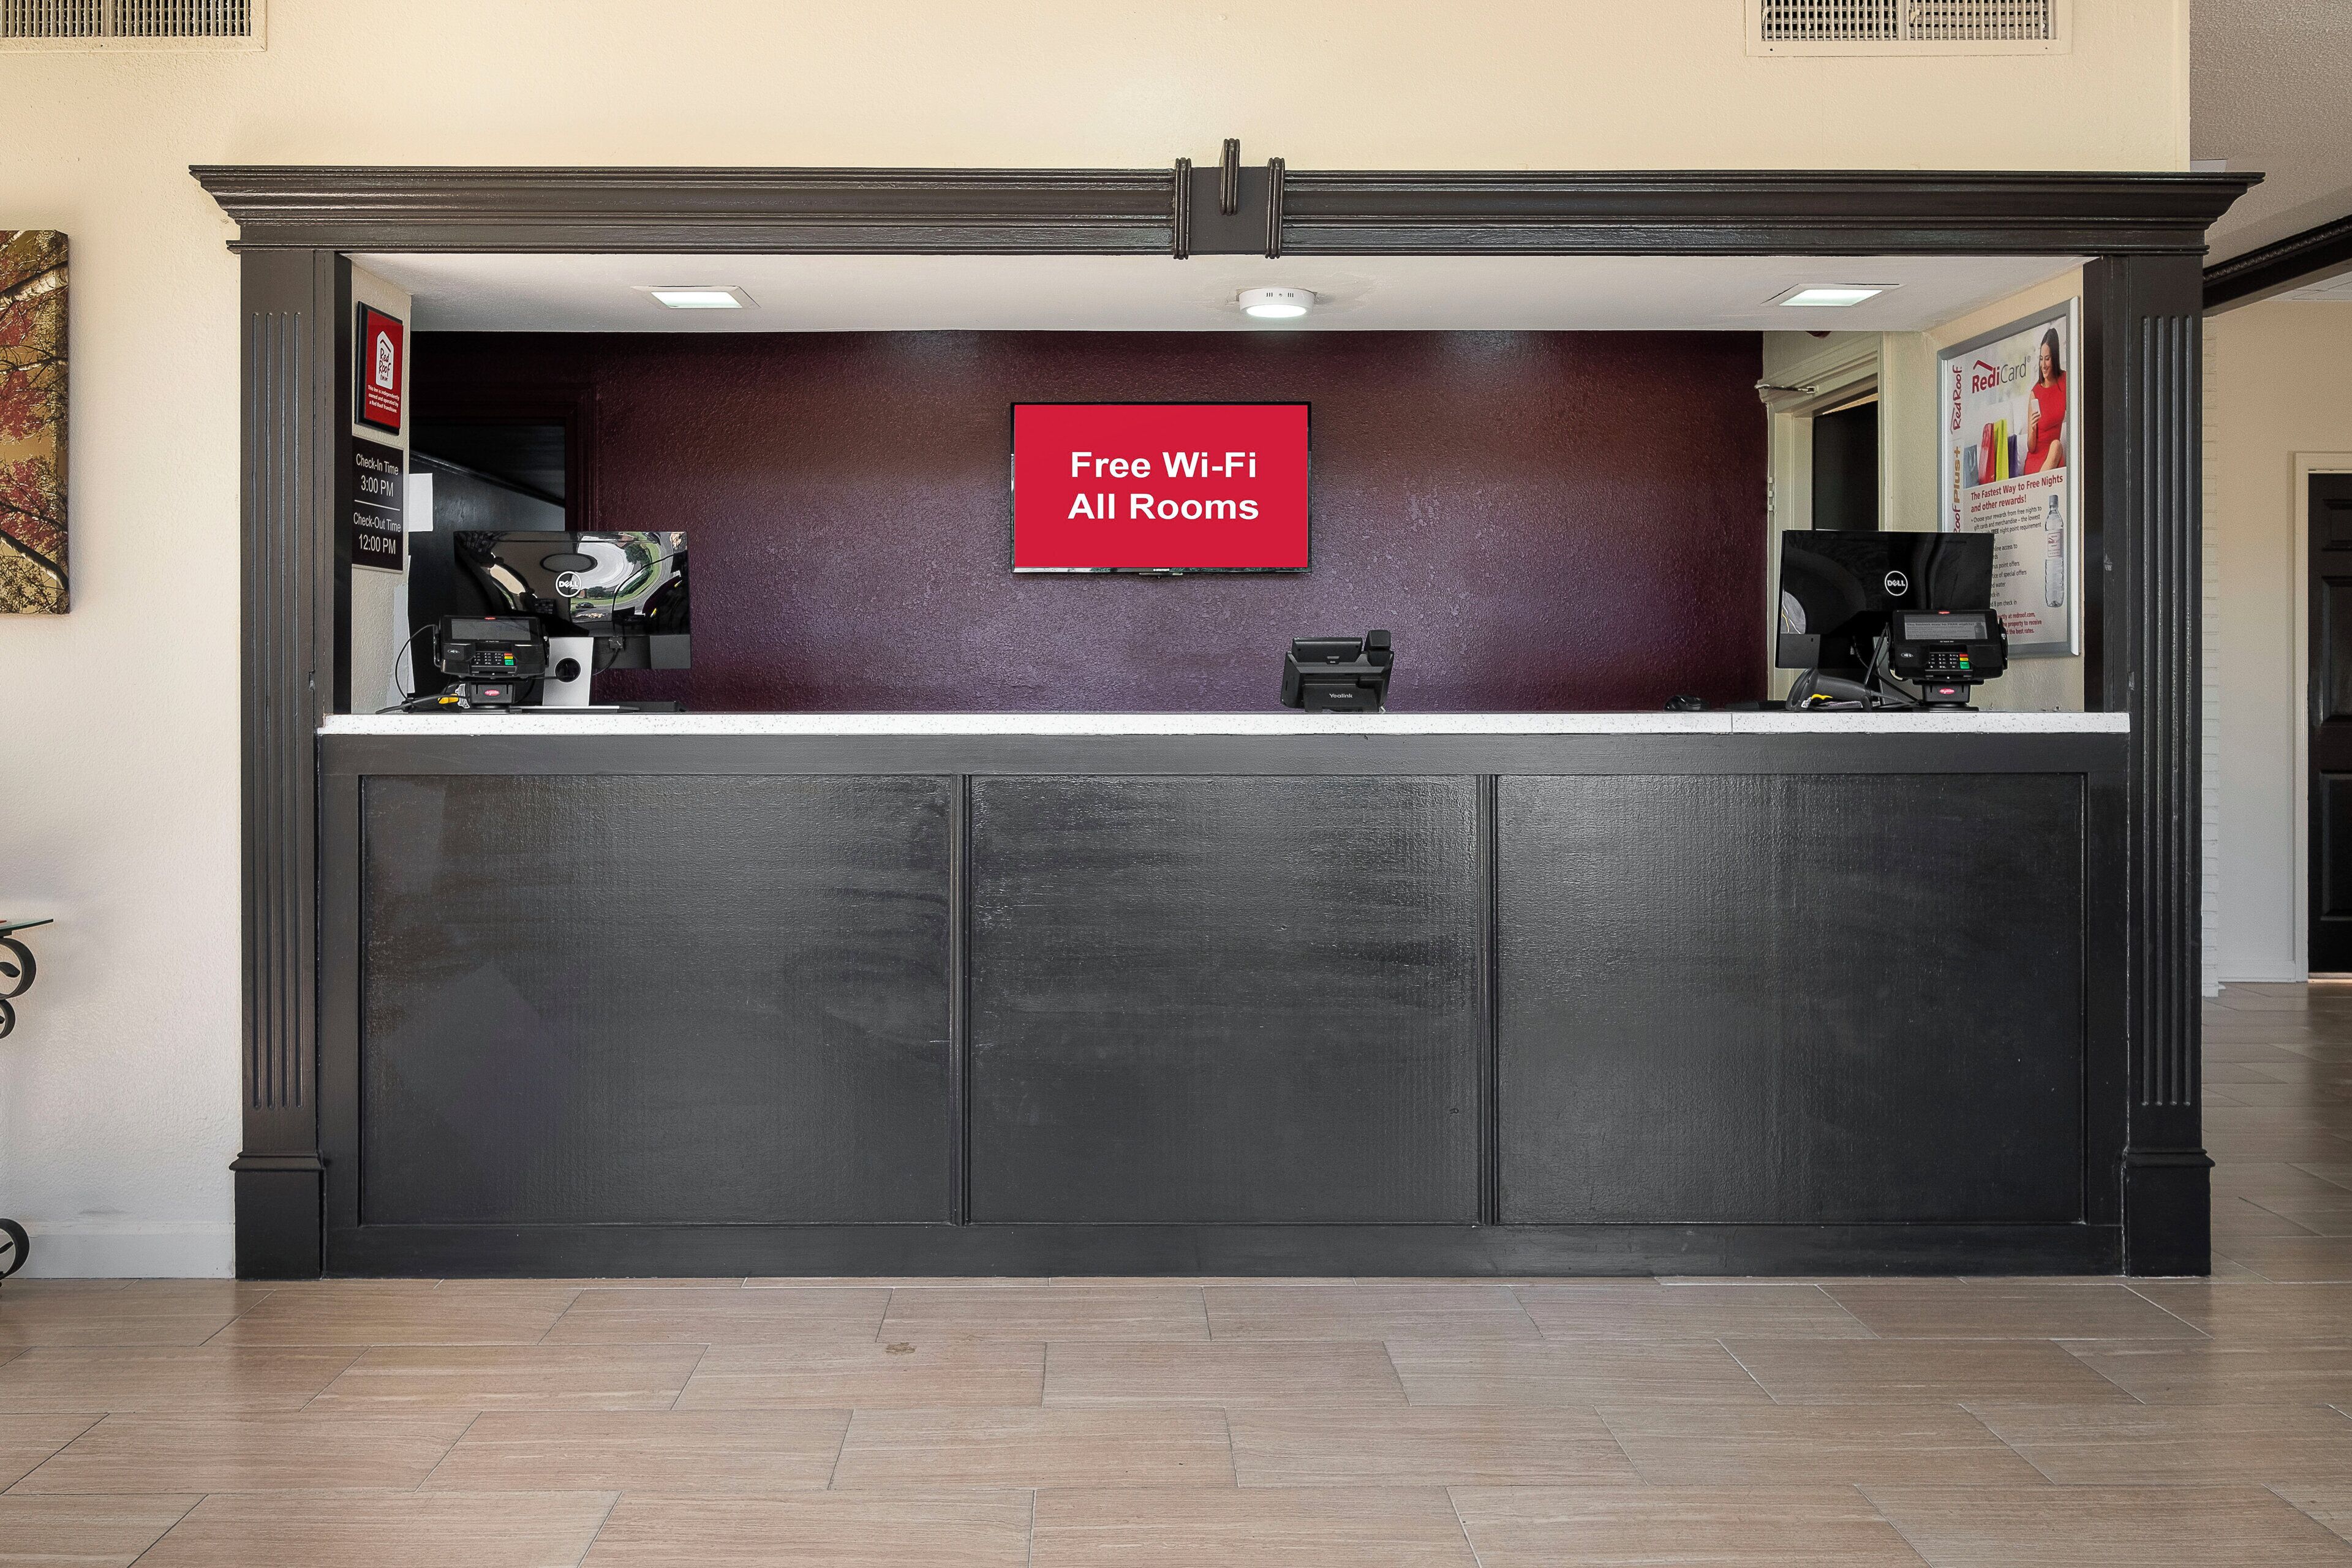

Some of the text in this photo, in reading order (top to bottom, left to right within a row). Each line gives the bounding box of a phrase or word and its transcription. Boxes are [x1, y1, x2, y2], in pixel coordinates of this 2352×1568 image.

[380, 348, 390, 363] Red
[379, 363, 391, 377] Roof
[381, 390, 399, 401] independently
[356, 453, 398, 475] Check-In Time
[1071, 451, 1256, 478] Free Wi-Fi
[361, 475, 393, 497] 3:00 PM
[1971, 492, 1980, 500] The
[1982, 486, 2002, 499] Fastest
[2003, 484, 2016, 494] Way
[2027, 480, 2040, 489] Free
[2041, 475, 2063, 487] Nights
[1068, 493, 1259, 520] All Rooms
[1971, 494, 2027, 513] and other rewards!
[353, 512, 401, 533] Check-Out Time
[2020, 522, 2041, 531] requirement
[359, 533, 396, 555] 12:00 PM
